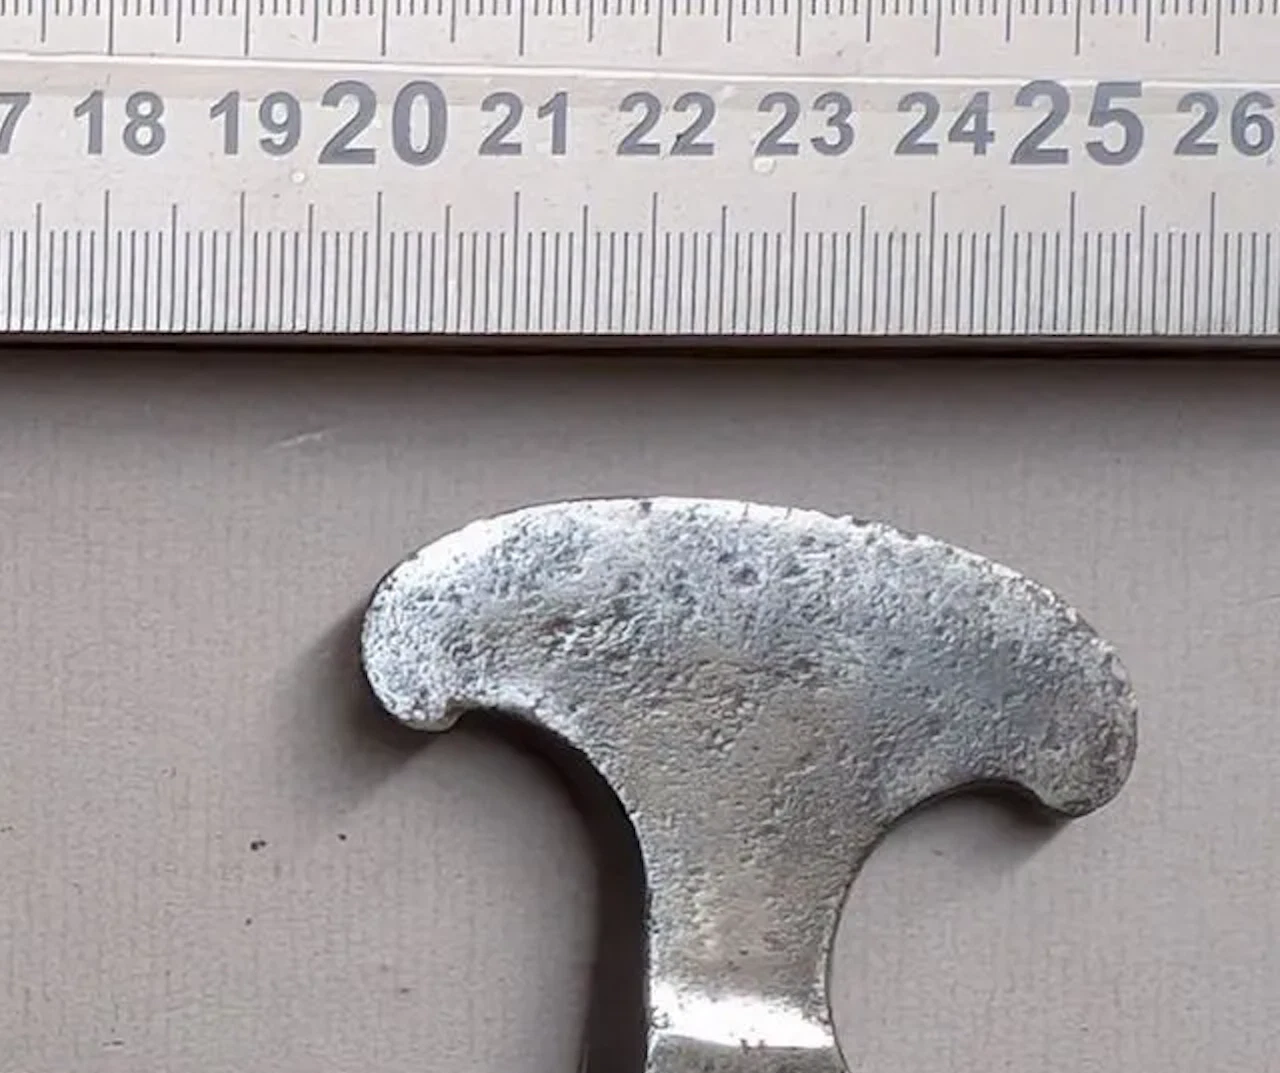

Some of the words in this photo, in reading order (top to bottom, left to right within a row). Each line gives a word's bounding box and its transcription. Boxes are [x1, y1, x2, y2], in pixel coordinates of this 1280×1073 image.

[74, 89, 166, 156] 18
[210, 90, 301, 156] 19
[318, 80, 447, 166] 20
[478, 91, 569, 156] 21
[616, 91, 716, 156] 22
[754, 91, 854, 157] 23
[894, 91, 995, 156] 24
[1010, 80, 1144, 166] 25
[1173, 91, 1275, 156] 26
